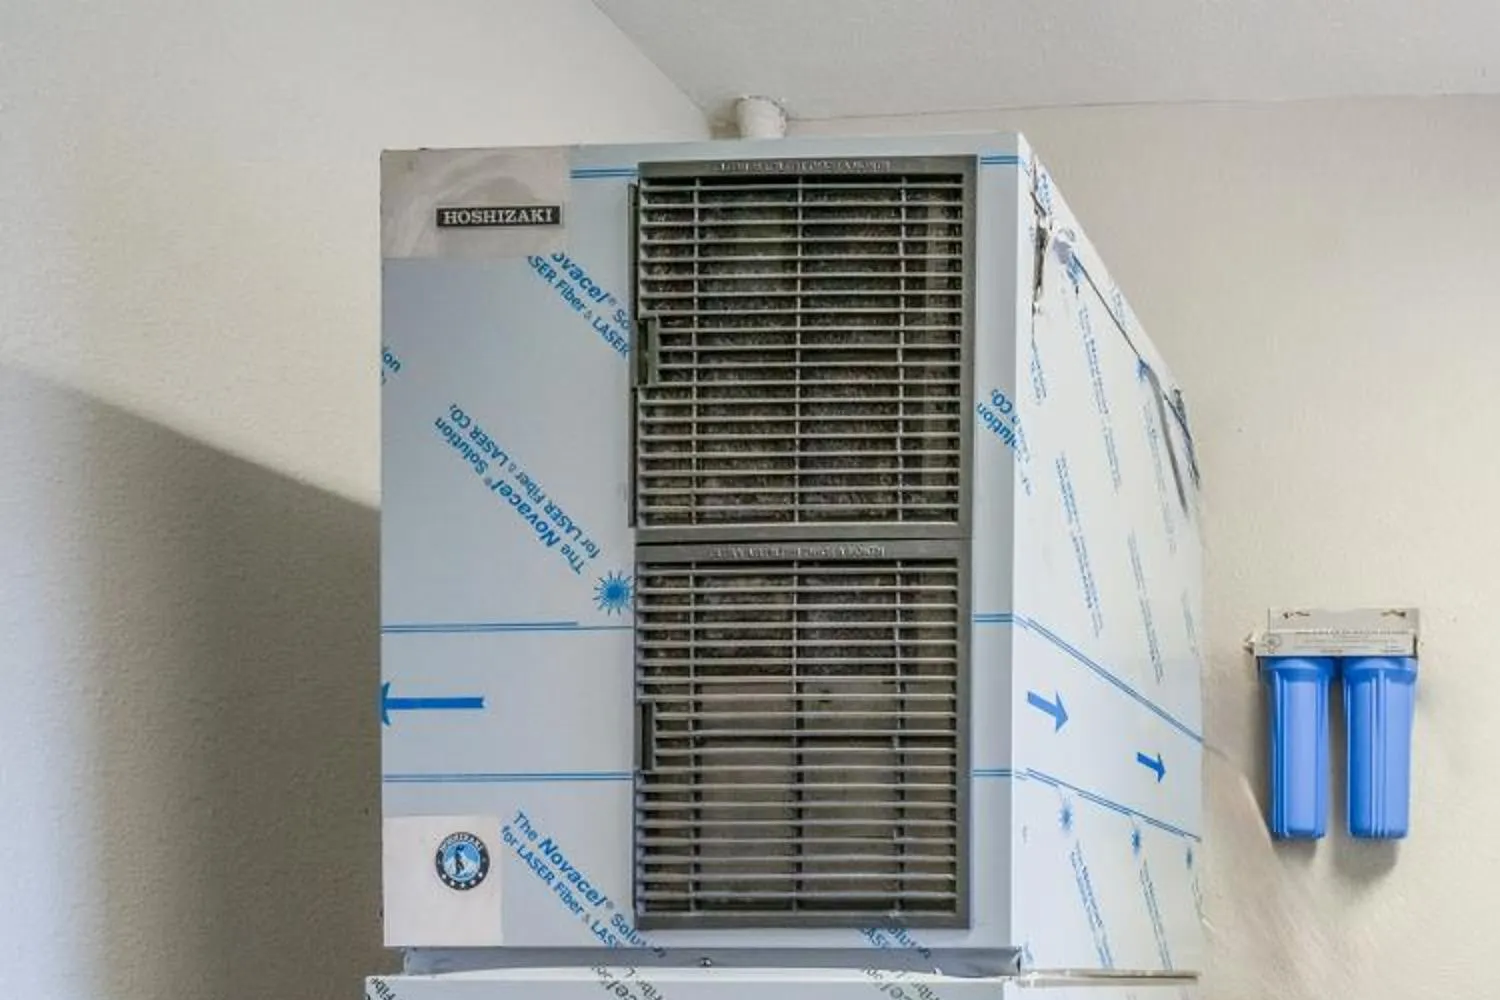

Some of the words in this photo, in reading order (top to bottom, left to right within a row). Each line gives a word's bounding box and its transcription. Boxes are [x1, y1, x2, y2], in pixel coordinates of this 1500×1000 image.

[442, 207, 553, 225] HOSHIZAKI
[435, 417, 489, 476] Solution
[470, 425, 509, 466] LASER
[515, 471, 548, 505] Fiber
[543, 499, 583, 542] LASER
[560, 543, 585, 575] The
[581, 539, 601, 559] for
[513, 810, 539, 842] The
[516, 844, 556, 886] LASER
[553, 881, 585, 916] Fiber
